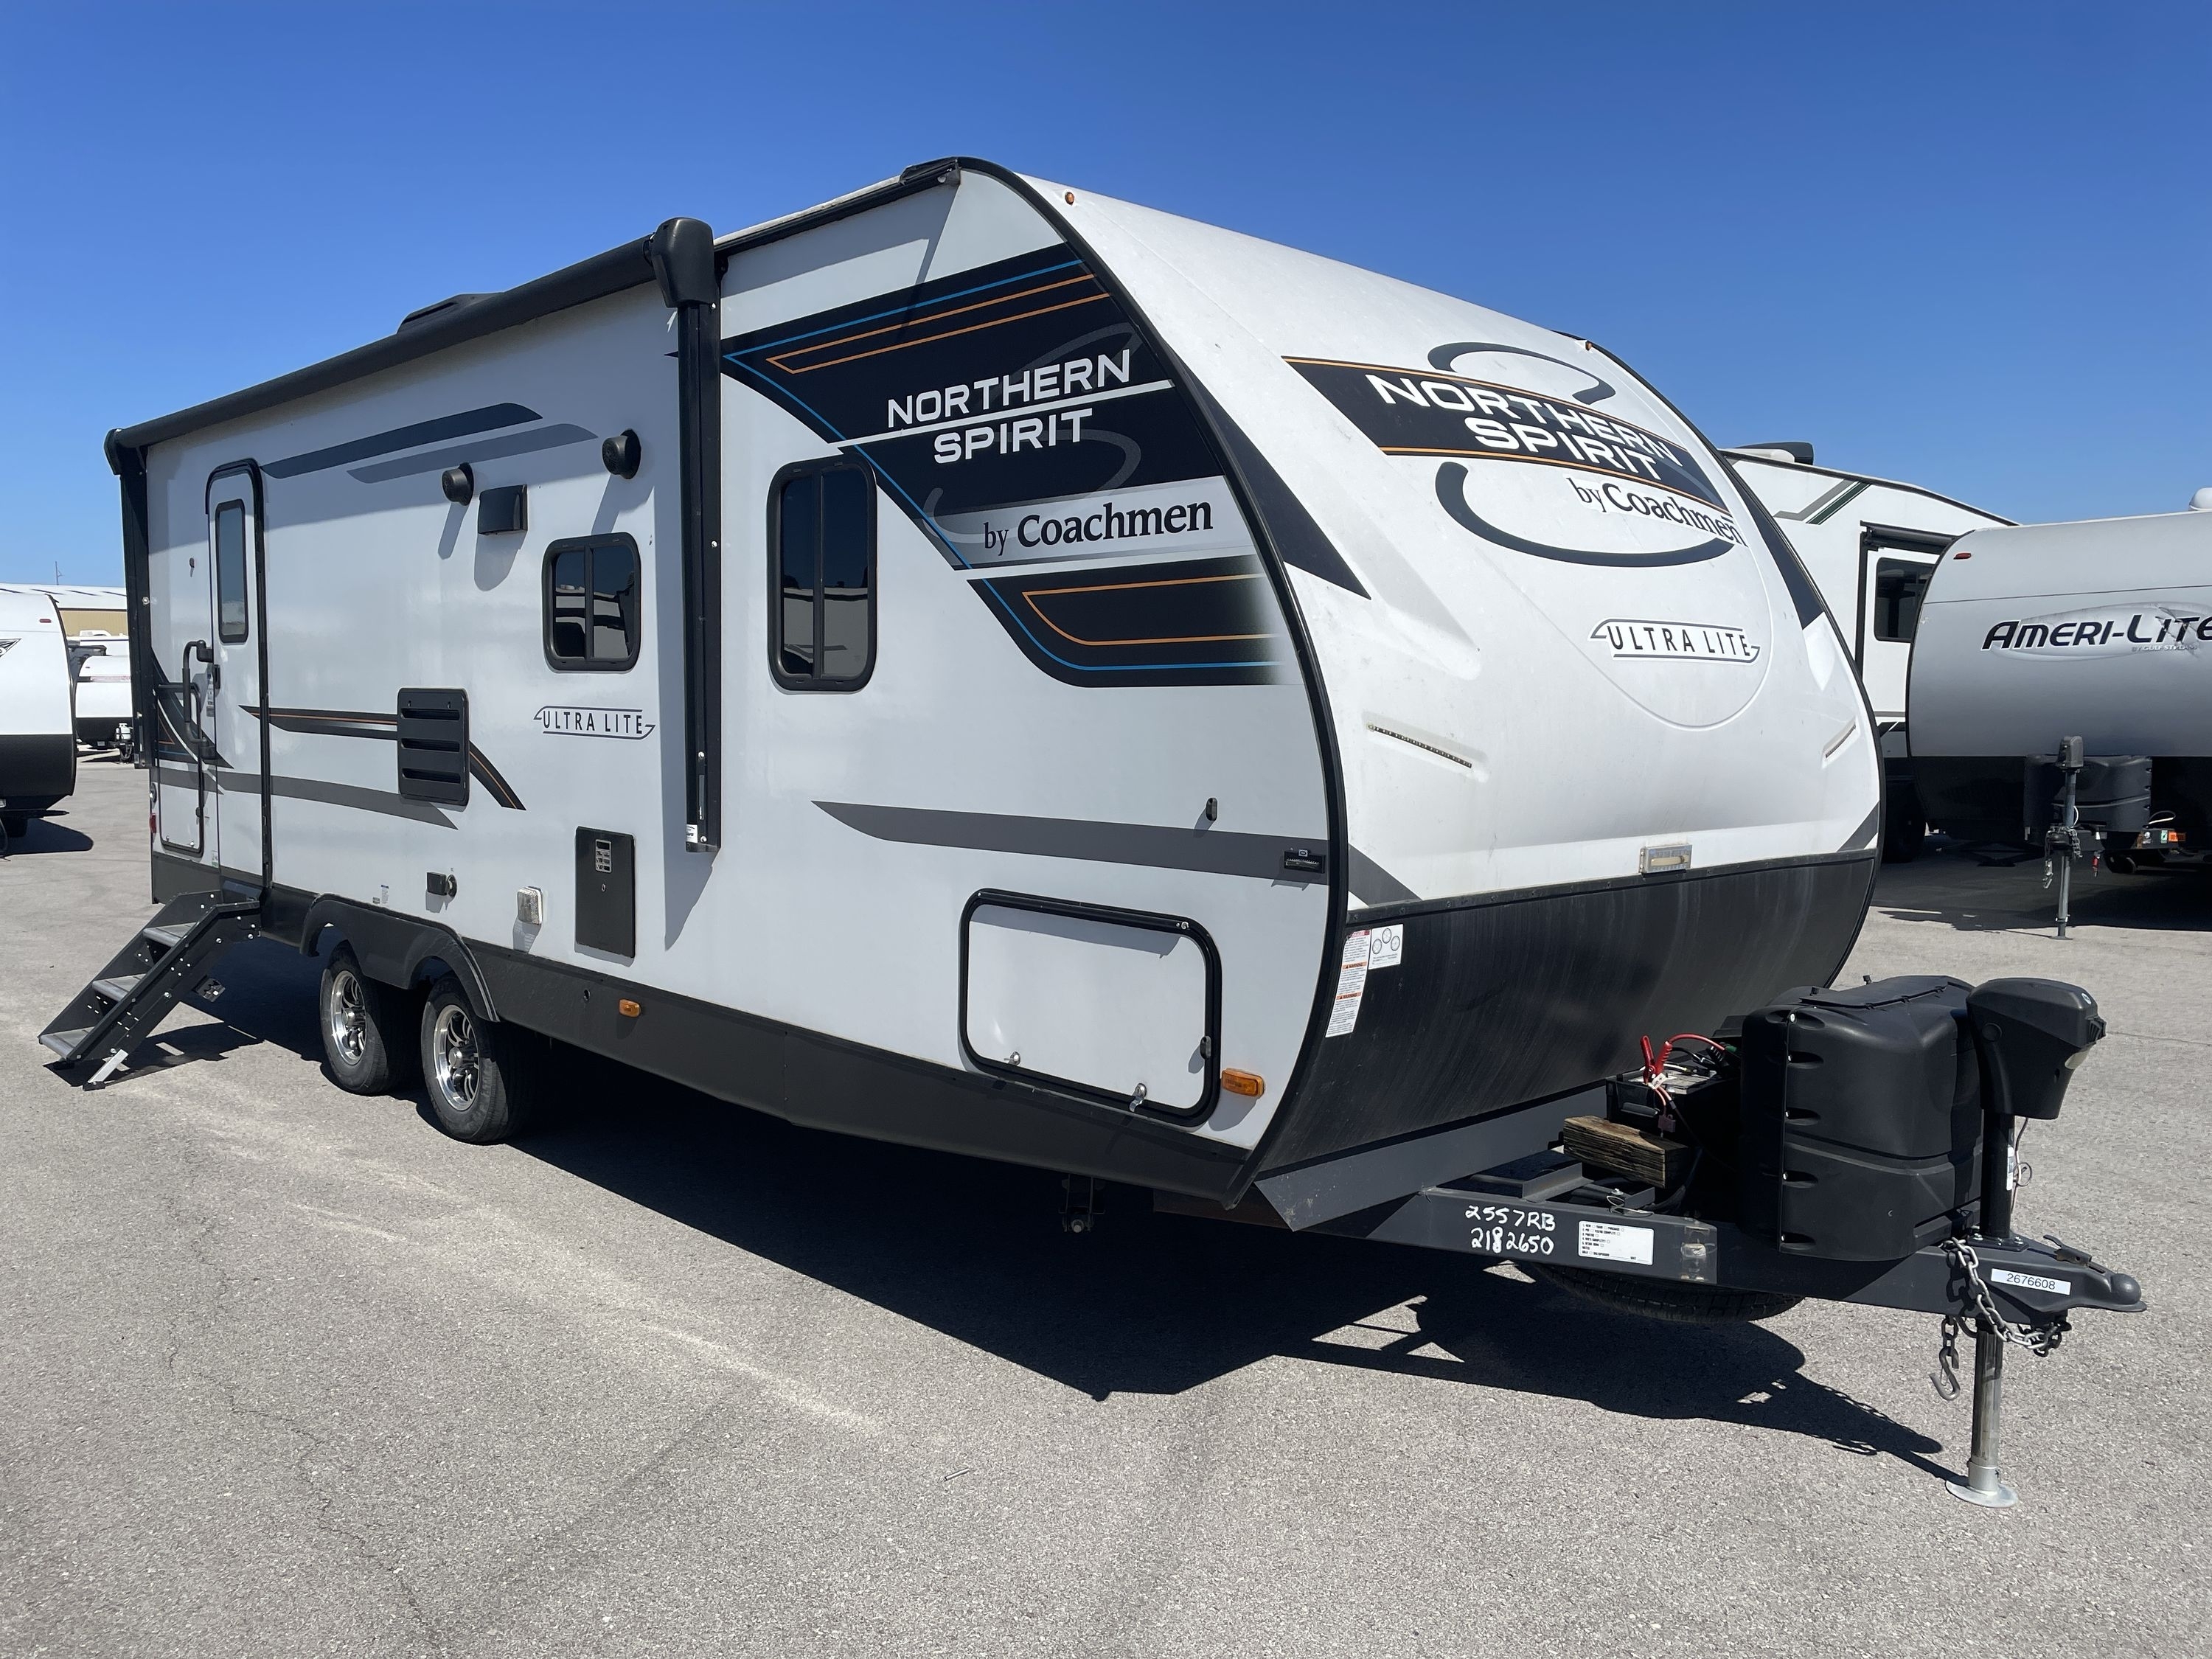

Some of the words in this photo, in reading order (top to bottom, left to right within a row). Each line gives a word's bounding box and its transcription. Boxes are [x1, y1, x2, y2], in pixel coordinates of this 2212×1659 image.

[888, 349, 1130, 428] NORTHERN
[934, 408, 1093, 464] SPIRIT
[1365, 374, 1683, 467] NORTHERN
[1464, 417, 1661, 480] SPIRIT
[983, 521, 1009, 556] by
[1017, 501, 1214, 548] Coachmen
[1565, 477, 1607, 512] by
[1601, 482, 1749, 547] Coachmen
[1607, 625, 1695, 652] ULTRA
[1703, 630, 1750, 656] LITE
[543, 710, 595, 731] ULTRA
[605, 714, 642, 734] LITE
[1464, 1205, 1556, 1231] 2557RB
[2006, 1273, 2056, 1290] 2676608
